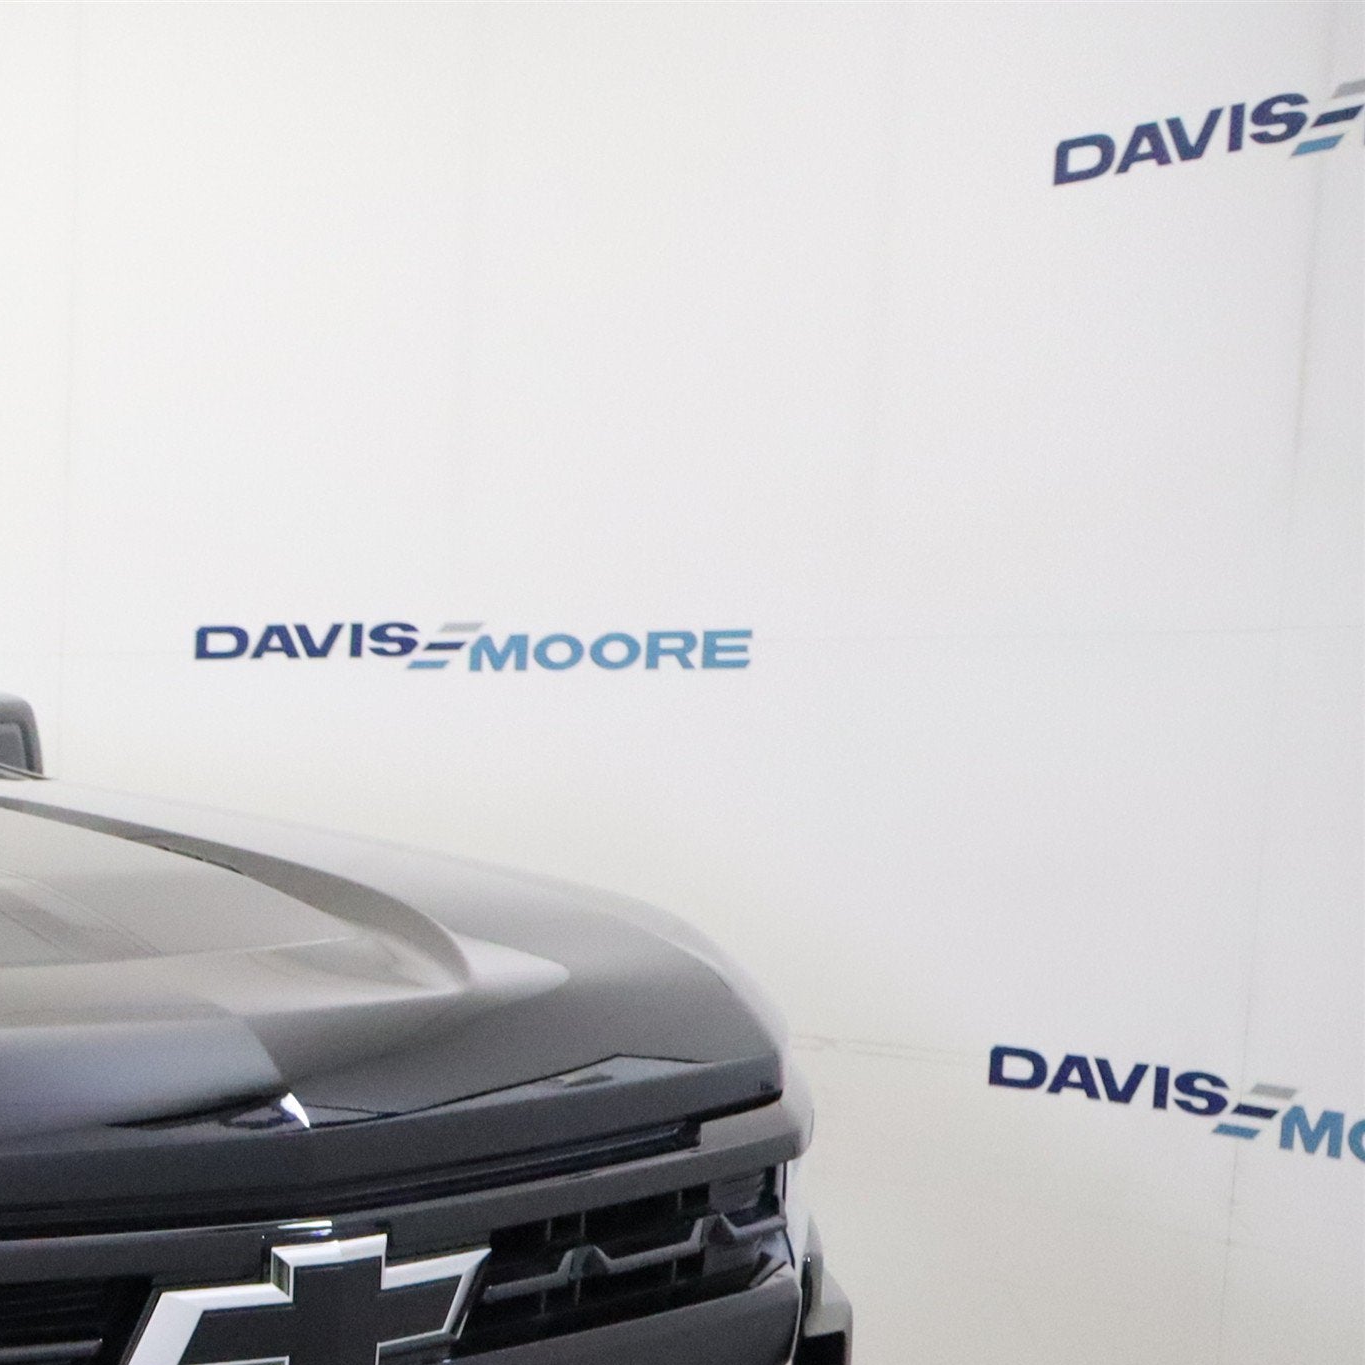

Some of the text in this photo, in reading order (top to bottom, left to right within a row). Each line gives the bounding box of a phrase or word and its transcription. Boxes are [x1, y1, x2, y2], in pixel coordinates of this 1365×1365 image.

[1053, 92, 1309, 186] DAVIS
[194, 622, 753, 672] DAVIS MOORE
[988, 1045, 1229, 1117] DAVIS
